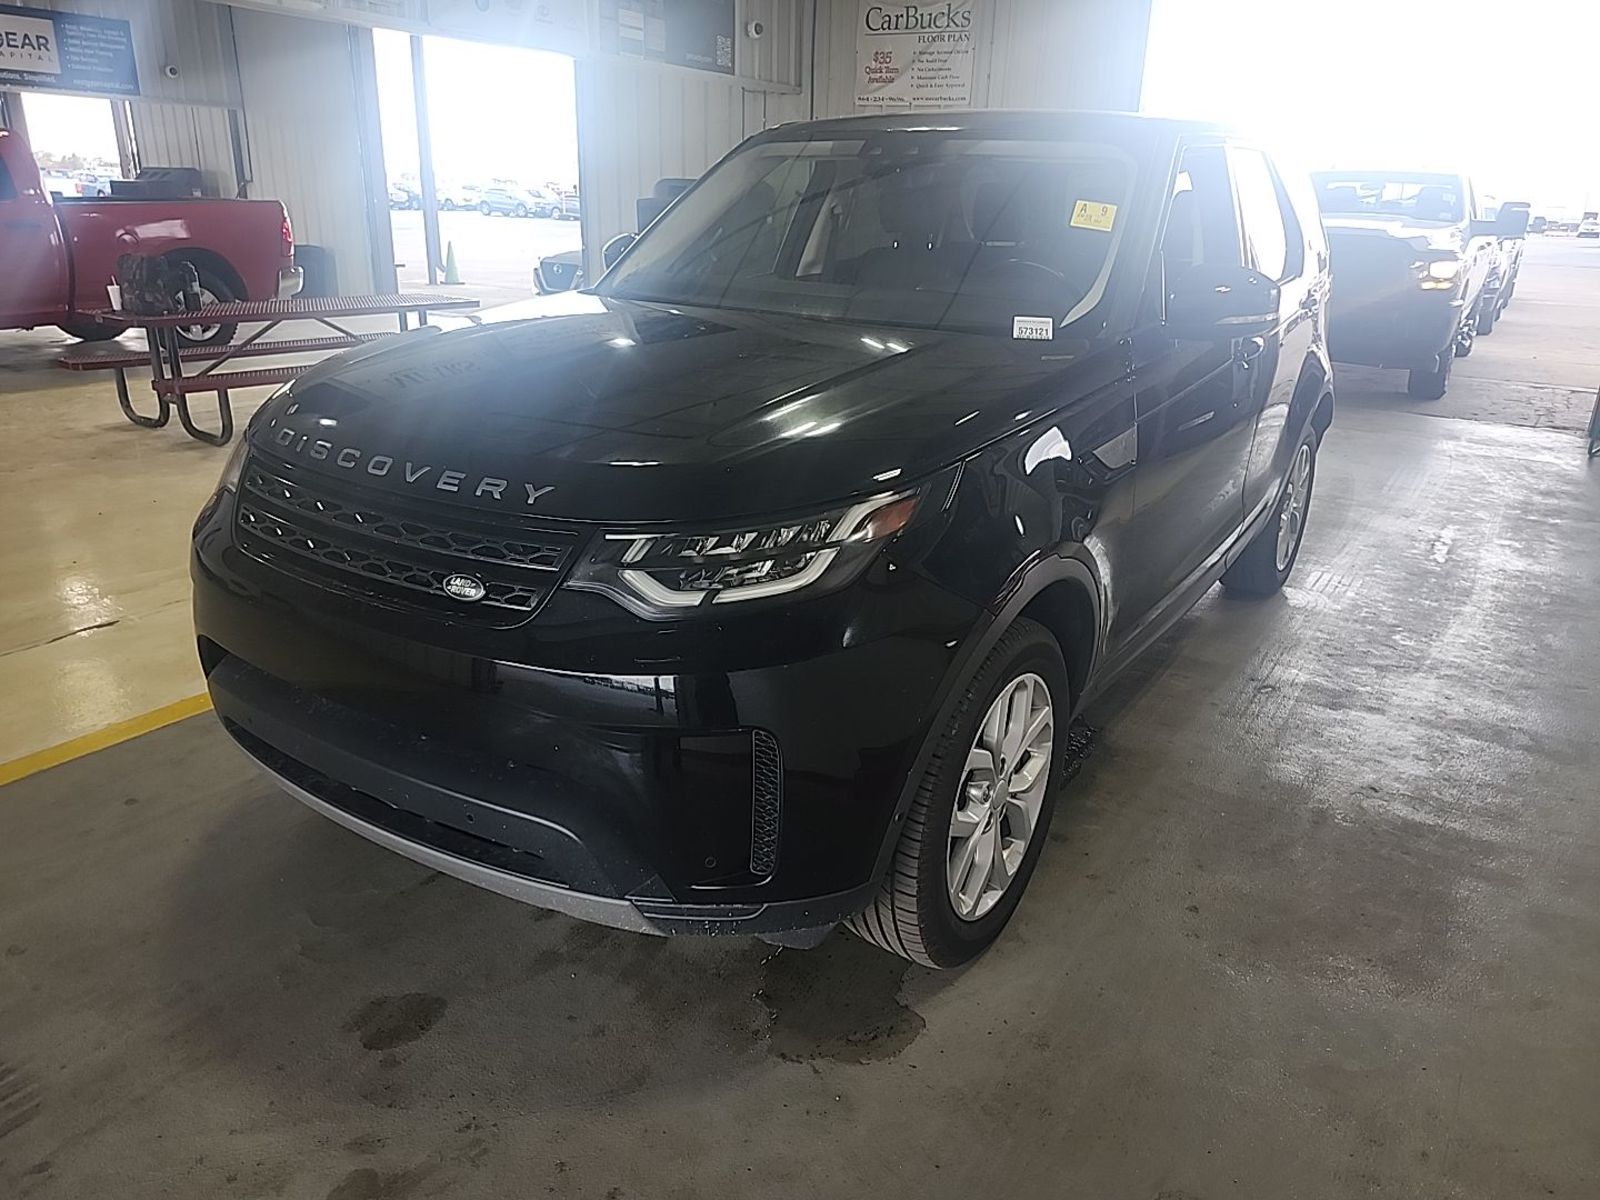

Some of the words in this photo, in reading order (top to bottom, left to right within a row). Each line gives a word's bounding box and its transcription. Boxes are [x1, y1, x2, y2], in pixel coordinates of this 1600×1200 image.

[865, 3, 971, 31] CarBucks
[918, 34, 946, 43] FLOOR
[947, 33, 970, 42] PLAN
[873, 51, 892, 64] $35
[1018, 326, 1049, 337] 573121
[275, 428, 556, 506] DISCOVERY
[450, 577, 472, 588] LAND
[450, 585, 476, 597] ROVER
